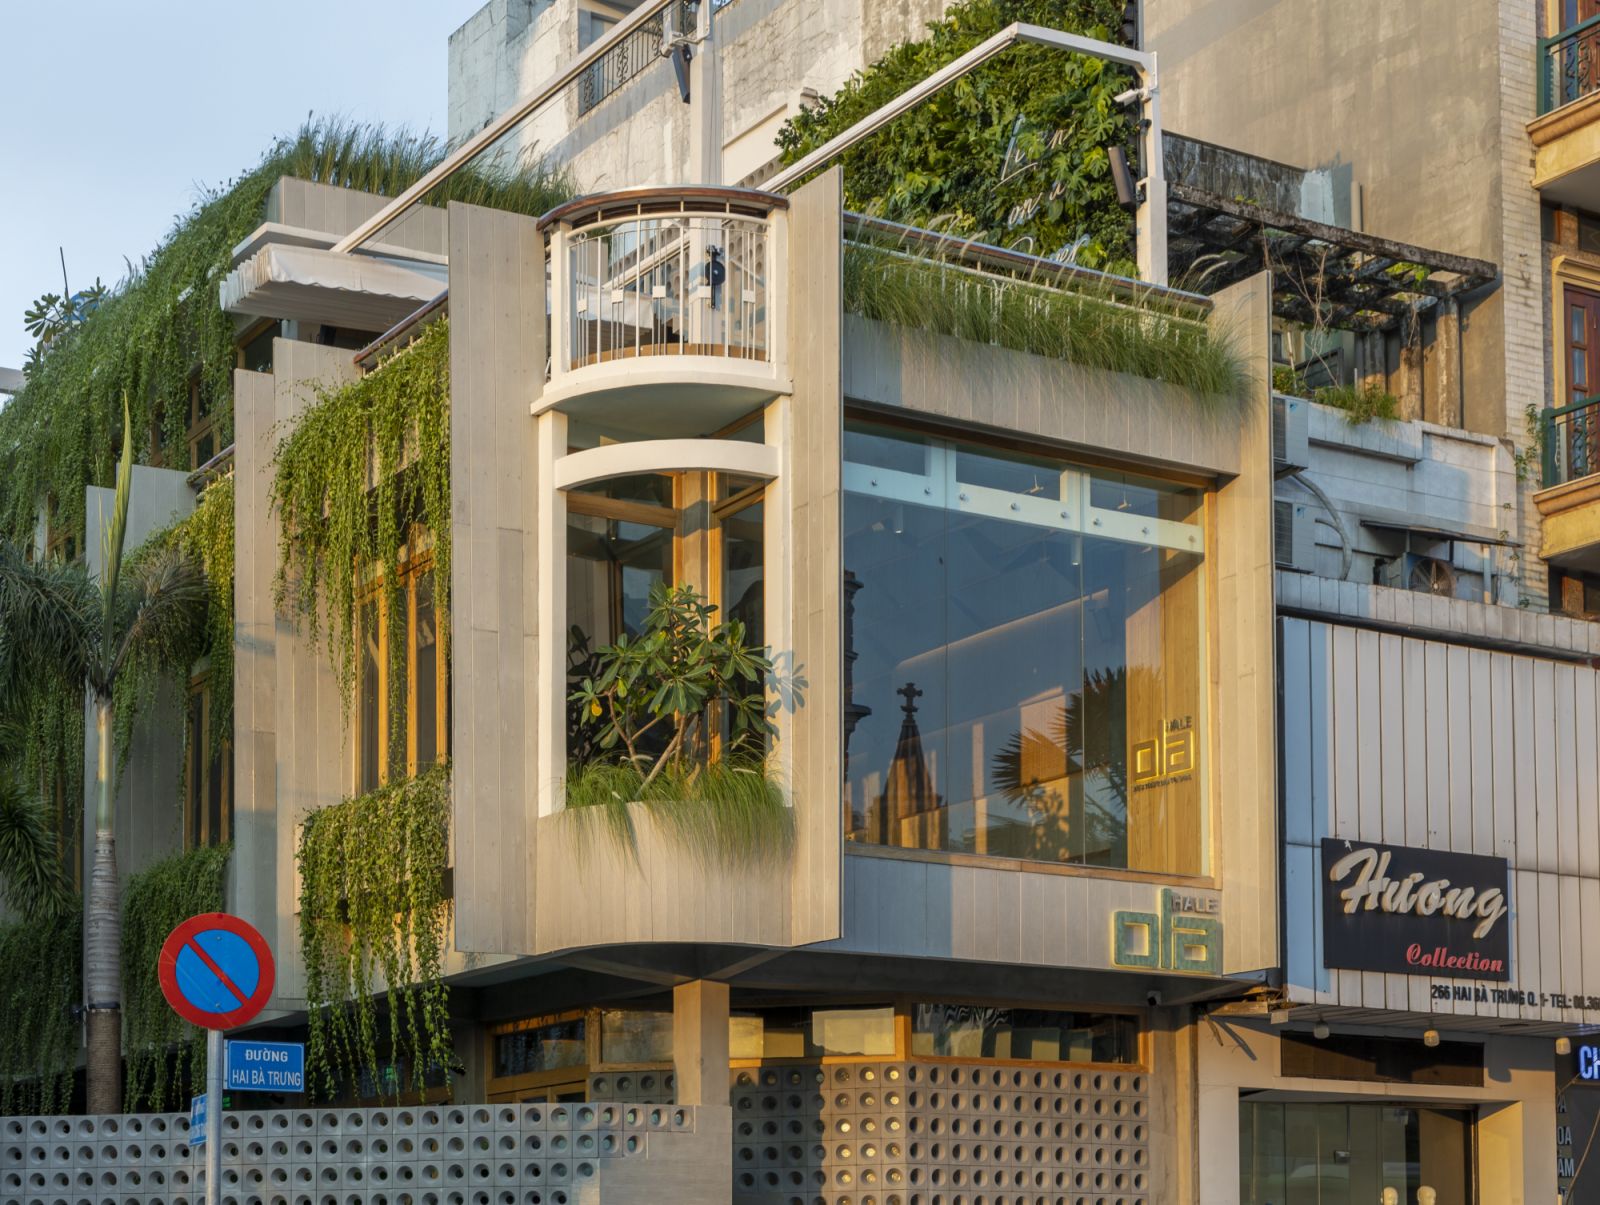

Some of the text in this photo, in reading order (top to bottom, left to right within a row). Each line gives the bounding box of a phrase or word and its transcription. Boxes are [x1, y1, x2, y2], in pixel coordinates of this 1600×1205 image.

[1329, 847, 1508, 939] Hương
[1172, 894, 1219, 916] HALE
[1406, 943, 1504, 973] Collection
[1431, 984, 1450, 1000] 266
[1453, 985, 1472, 1001] HAI
[1475, 984, 1488, 1002] BÀ
[245, 1048, 288, 1063] ĐƯỜNG
[232, 1067, 301, 1086] HAI BÀ TRƯNG
